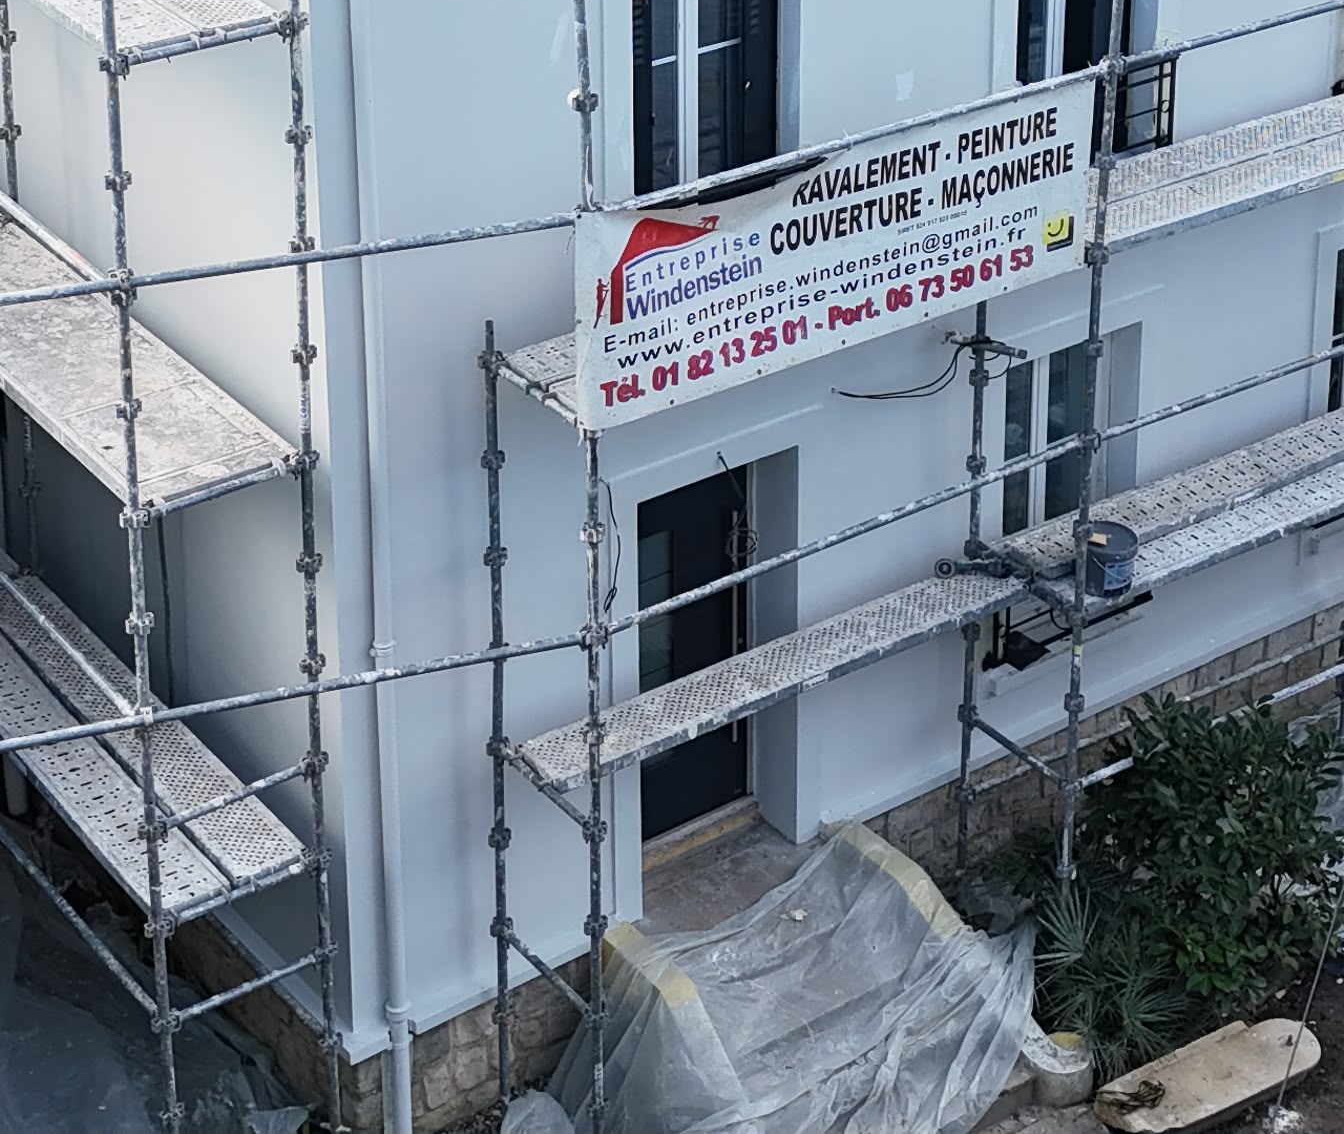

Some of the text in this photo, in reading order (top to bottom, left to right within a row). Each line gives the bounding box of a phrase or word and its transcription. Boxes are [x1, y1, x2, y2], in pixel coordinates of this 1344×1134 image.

[770, 187, 923, 255] COUVERTURE
[941, 142, 1075, 210] MAÇONNERIE
[792, 140, 941, 208] RAVALEMENT
[957, 106, 1058, 164] PEINTURE
[603, 206, 1038, 353] E-mail: entreprise.windenstein@gmail.com
[617, 227, 1026, 369] www.entreprise-windenstein.fr
[625, 232, 760, 293] Entreprise
[626, 254, 763, 320] Windenstein
[600, 373, 646, 407] Tél.
[651, 361, 680, 391] 01
[687, 349, 715, 381] 82
[719, 337, 746, 367] 13
[750, 325, 778, 357] 25
[782, 315, 808, 346] 01
[827, 296, 881, 331] Port.
[885, 283, 914, 312] 06
[918, 274, 945, 302] 73
[950, 264, 975, 292] 50
[979, 254, 1003, 282] 61
[1009, 244, 1034, 272] 53
